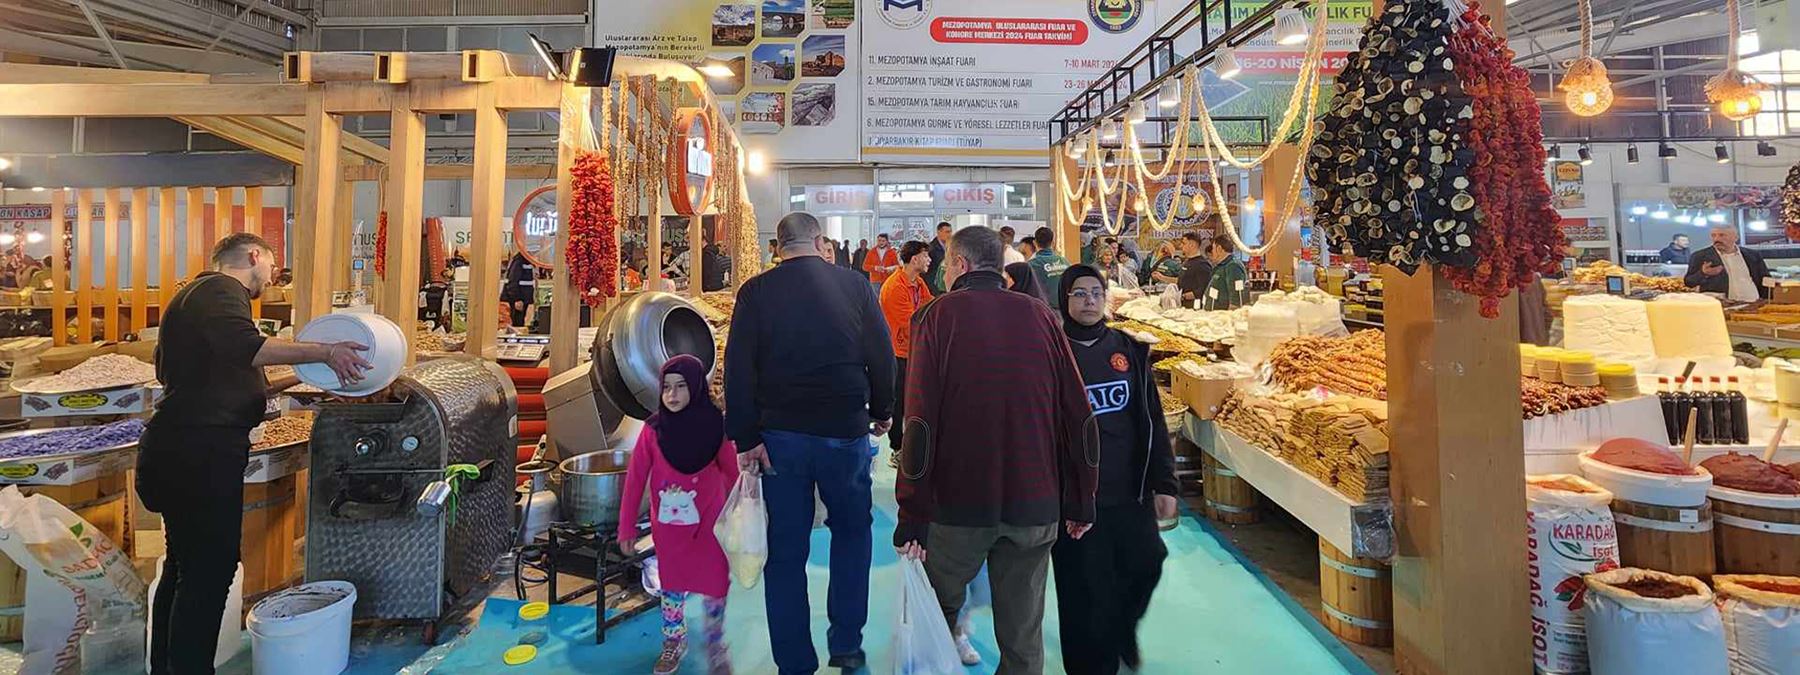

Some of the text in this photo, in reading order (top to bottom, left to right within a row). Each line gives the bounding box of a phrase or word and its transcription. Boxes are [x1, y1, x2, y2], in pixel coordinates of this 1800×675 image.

[942, 21, 1076, 31] MEZOPOTAMYA ULUSLARARASI FUAR VE
[677, 35, 698, 43] Talep
[946, 31, 1072, 40] KONGRE MERKEZİ 2024 FUAR TAKVİMİ
[658, 53, 696, 61] Buluşuyor
[868, 55, 976, 67] 11. MEZOPOTAMYA İNŞAAT FUARI
[1280, 56, 1328, 69] NİSN
[1064, 60, 1079, 69] 7-10
[1081, 60, 1100, 69] MART
[868, 75, 1033, 89] 2. MEZOPOTAMYA TURİZM VE GASTRONOMİ FUARI
[868, 97, 876, 107] 15.
[878, 97, 928, 108] MEZOPOTAMYA
[930, 98, 951, 108] TARIM
[875, 118, 926, 129] MEZOPOTAMYA
[927, 119, 952, 129] GURME
[953, 119, 962, 129] VE
[963, 118, 994, 129] YÖRESEL
[995, 120, 1031, 130] LEZZETLER
[15, 206, 50, 218] KASAP
[1088, 385, 1126, 410] AIG
